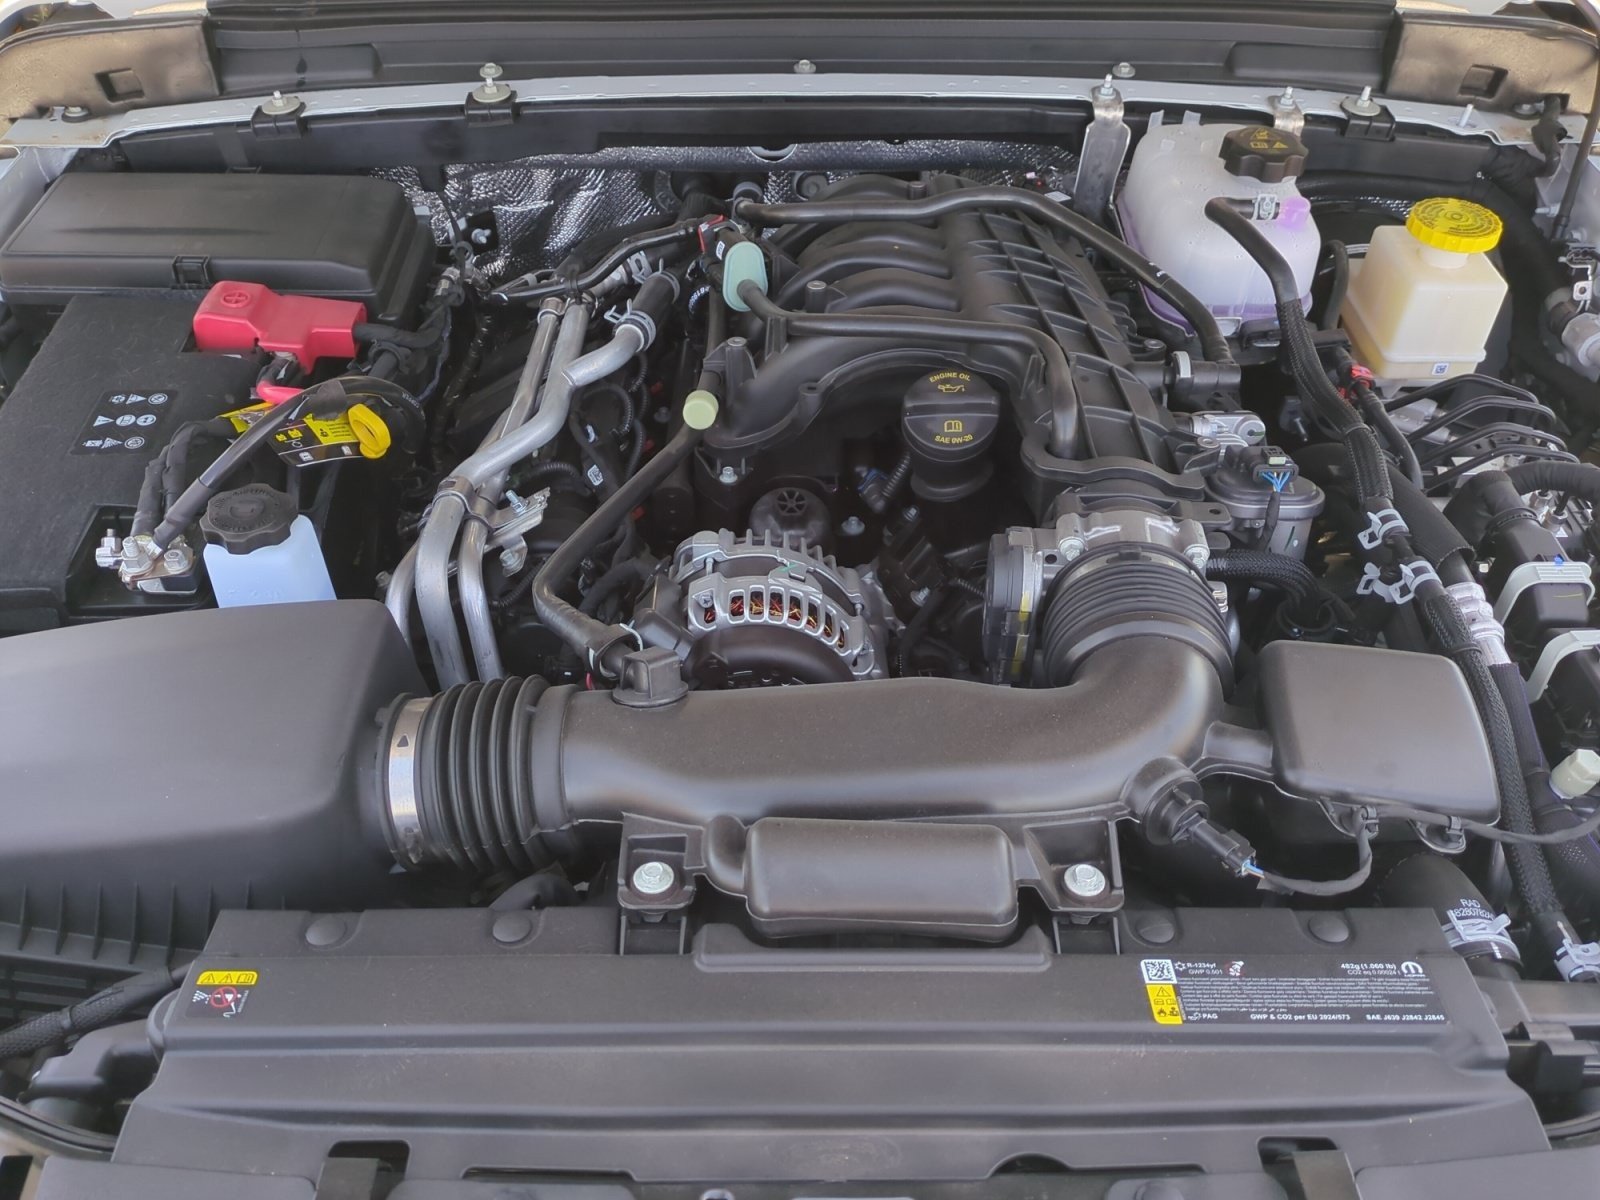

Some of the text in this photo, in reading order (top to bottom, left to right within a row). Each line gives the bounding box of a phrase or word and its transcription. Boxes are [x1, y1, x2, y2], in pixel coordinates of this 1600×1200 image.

[929, 372, 971, 383] ENGINE OIL
[934, 434, 973, 444] SAE 0W-20
